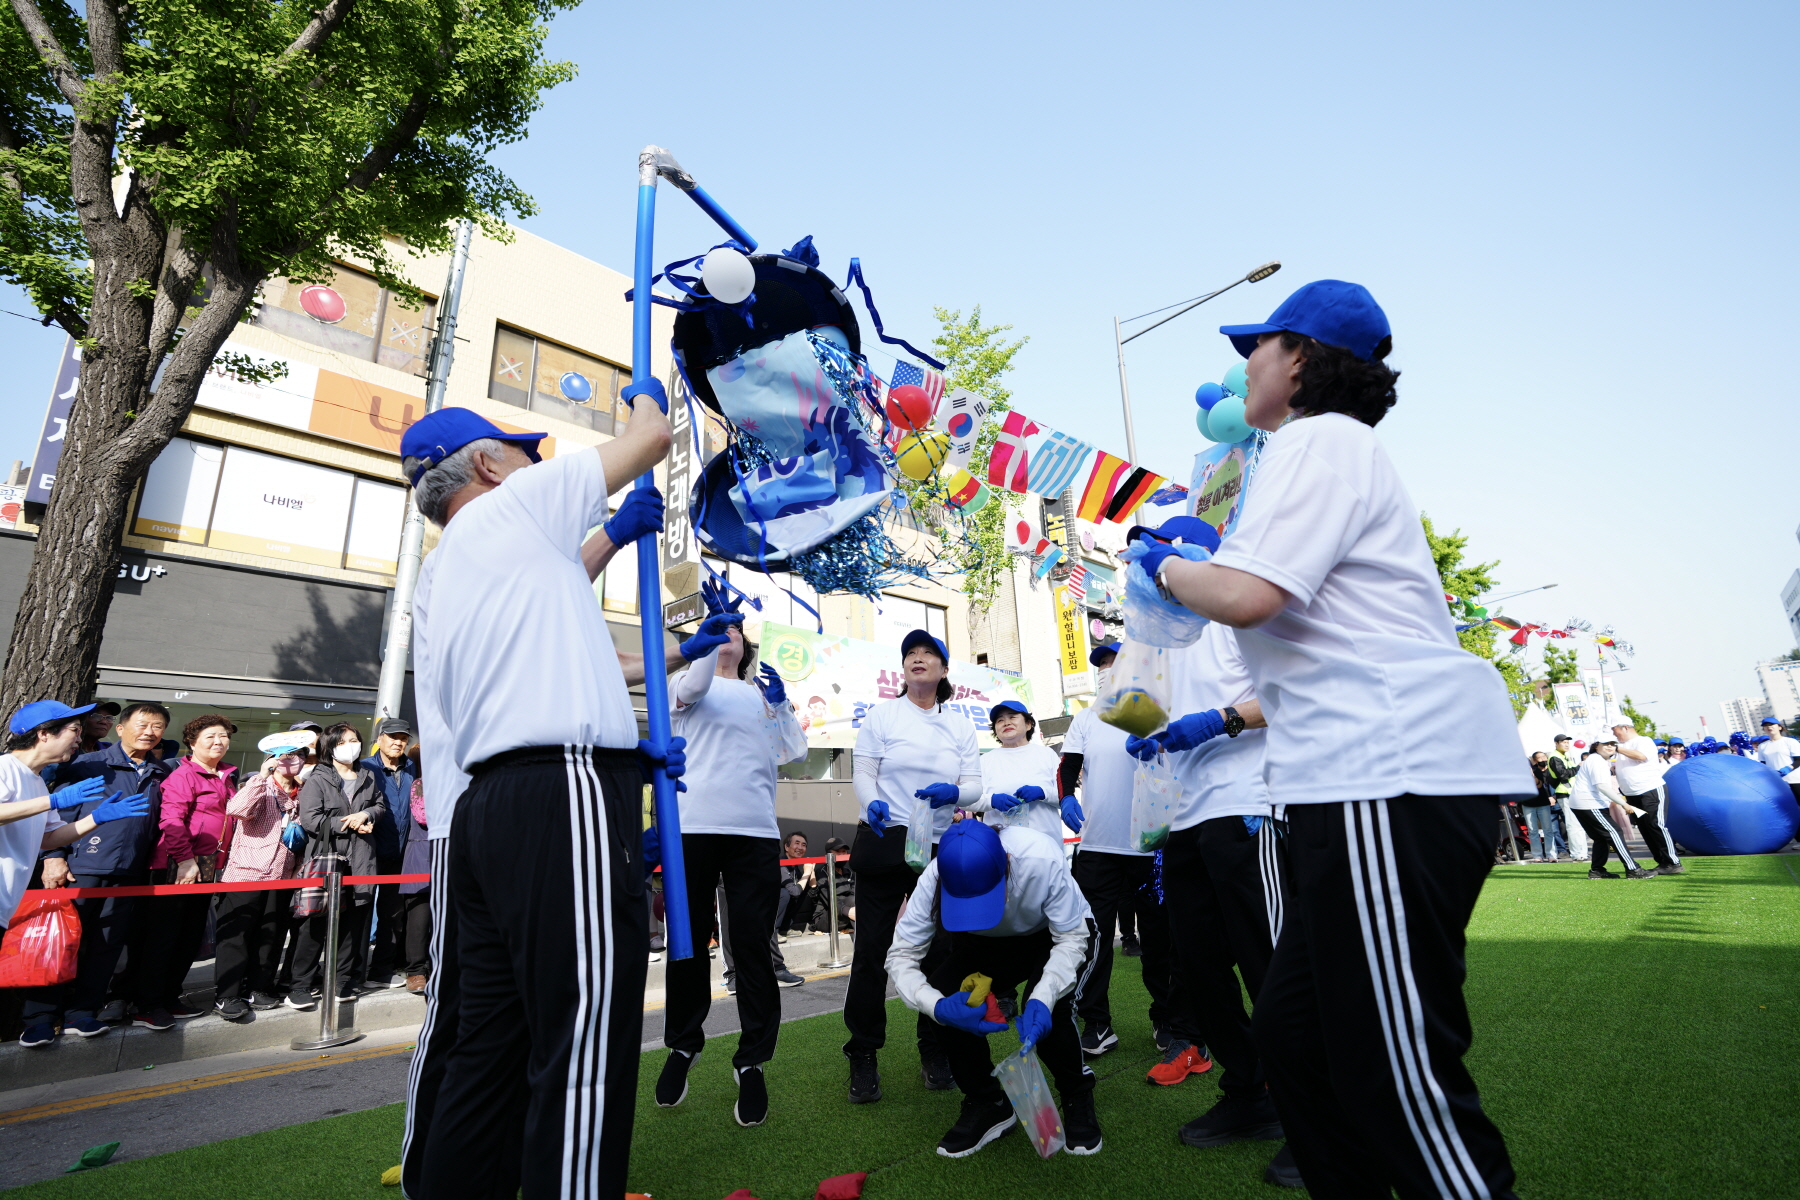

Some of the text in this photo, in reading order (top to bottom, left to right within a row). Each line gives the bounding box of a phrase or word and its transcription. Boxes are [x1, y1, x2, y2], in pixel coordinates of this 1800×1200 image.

[263, 493, 304, 510] 나비엘
[781, 643, 804, 671] 경
[174, 691, 189, 700] U+
